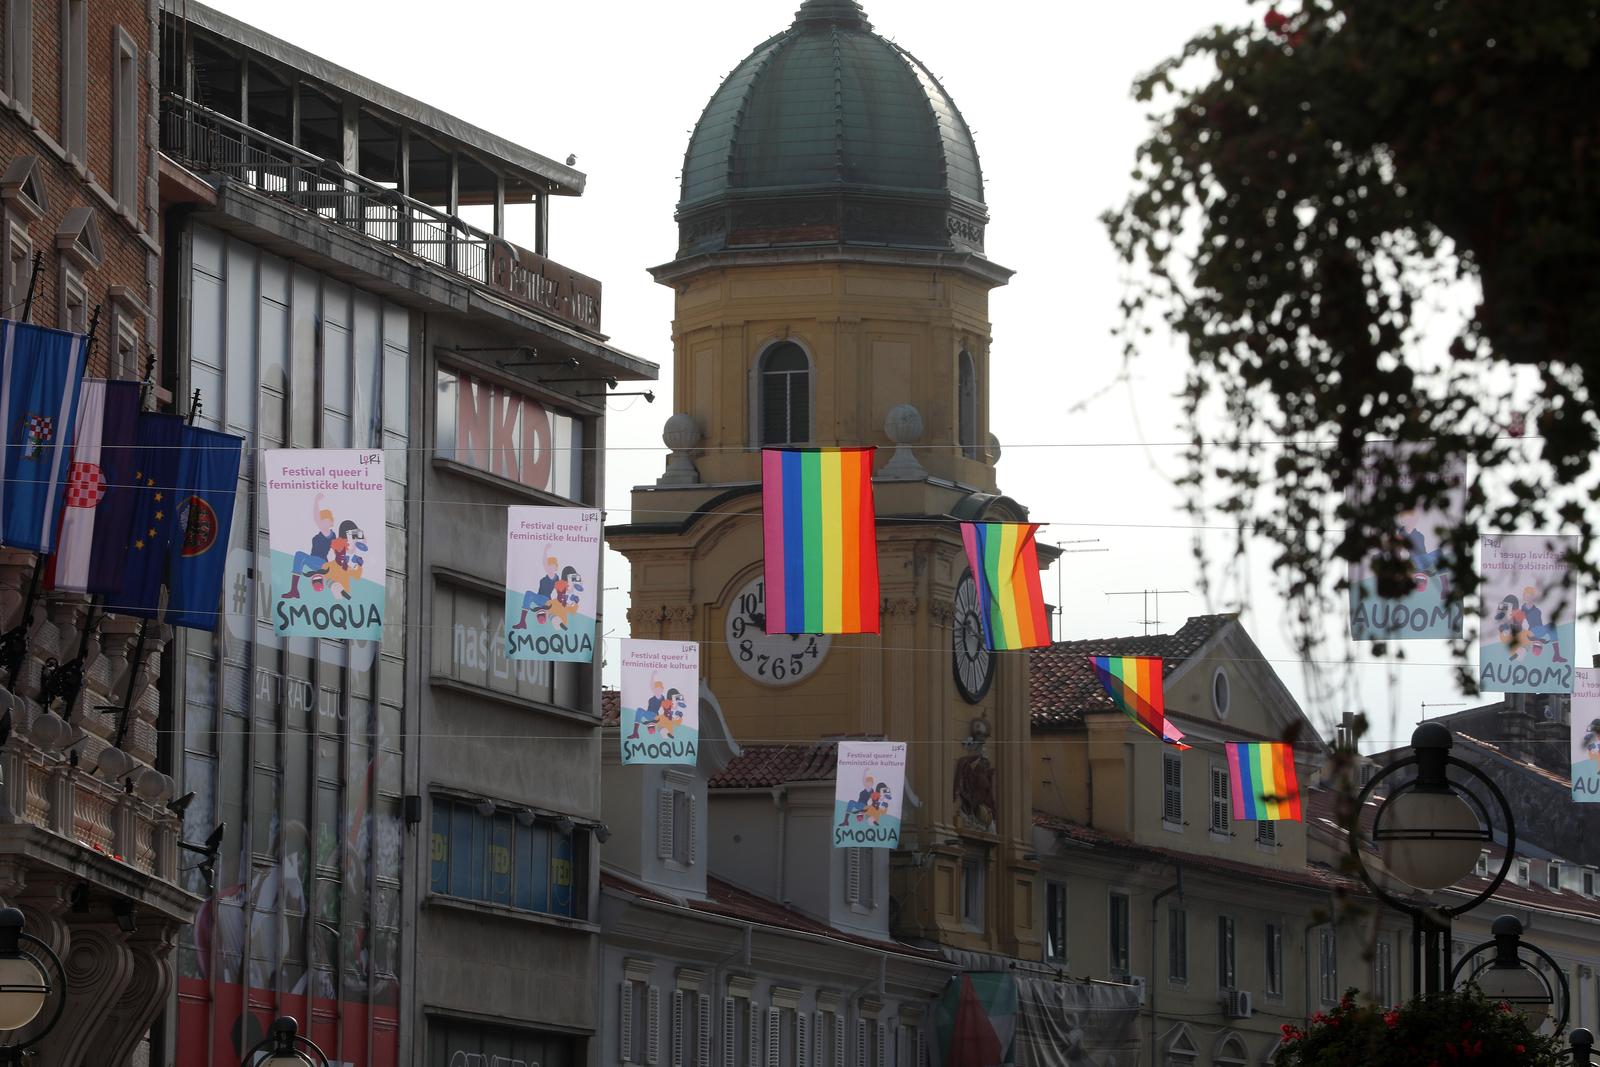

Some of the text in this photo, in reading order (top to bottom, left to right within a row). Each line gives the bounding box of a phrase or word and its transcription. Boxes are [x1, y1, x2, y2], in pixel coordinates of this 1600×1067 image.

[458, 370, 552, 492] NKD
[282, 466, 369, 479] Festival queer i
[269, 479, 383, 491] feminističke kulture
[520, 520, 554, 530] Festival
[557, 523, 583, 532] queer
[509, 531, 598, 544] feminističke kulture
[738, 592, 757, 615] 10
[276, 600, 382, 631] SMOQUA
[732, 616, 746, 639] 9
[508, 630, 592, 655] SMOQUA
[739, 639, 753, 661] 8
[804, 637, 819, 658] 4
[622, 660, 698, 670] feminističke kulture
[631, 651, 660, 660] Festival
[662, 654, 684, 662] queer
[757, 654, 770, 676] 7
[790, 652, 804, 676] 5
[772, 657, 786, 680] 6
[623, 740, 696, 760] SMOQUA
[835, 827, 898, 845] SMOQUA
